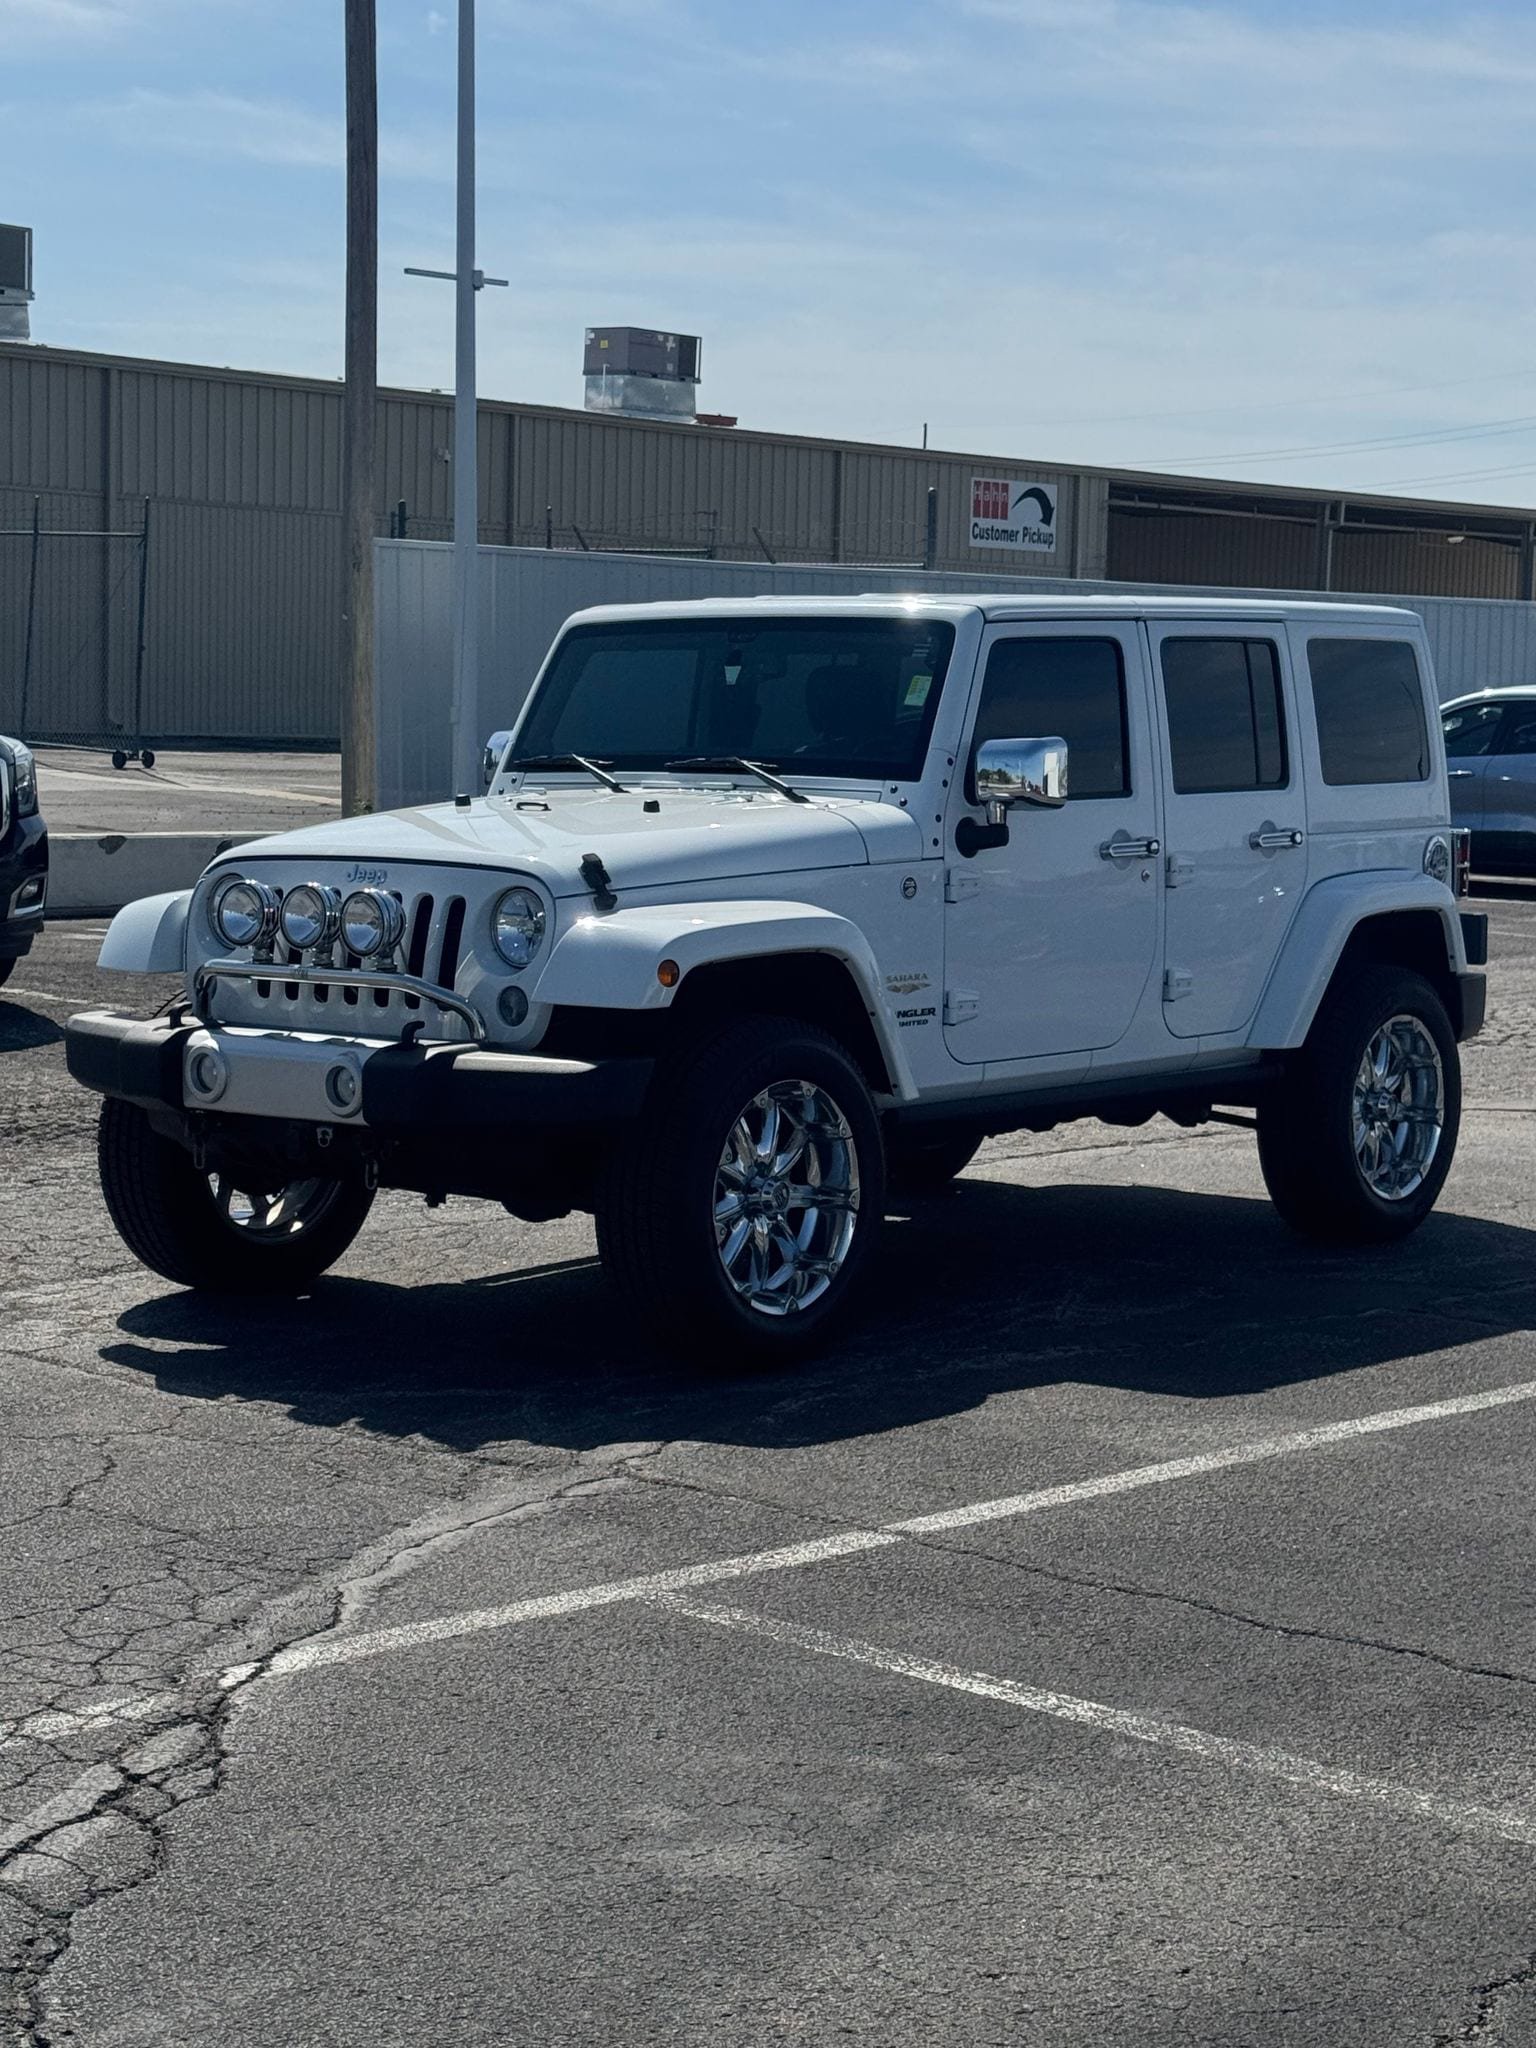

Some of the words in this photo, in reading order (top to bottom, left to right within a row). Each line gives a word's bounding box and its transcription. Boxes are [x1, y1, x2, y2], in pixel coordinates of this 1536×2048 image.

[972, 522, 1019, 542] Customer
[1022, 526, 1054, 549] Pickup
[347, 863, 388, 887] Jeep
[886, 973, 928, 983] SAHARA
[895, 1007, 936, 1018] NGLER
